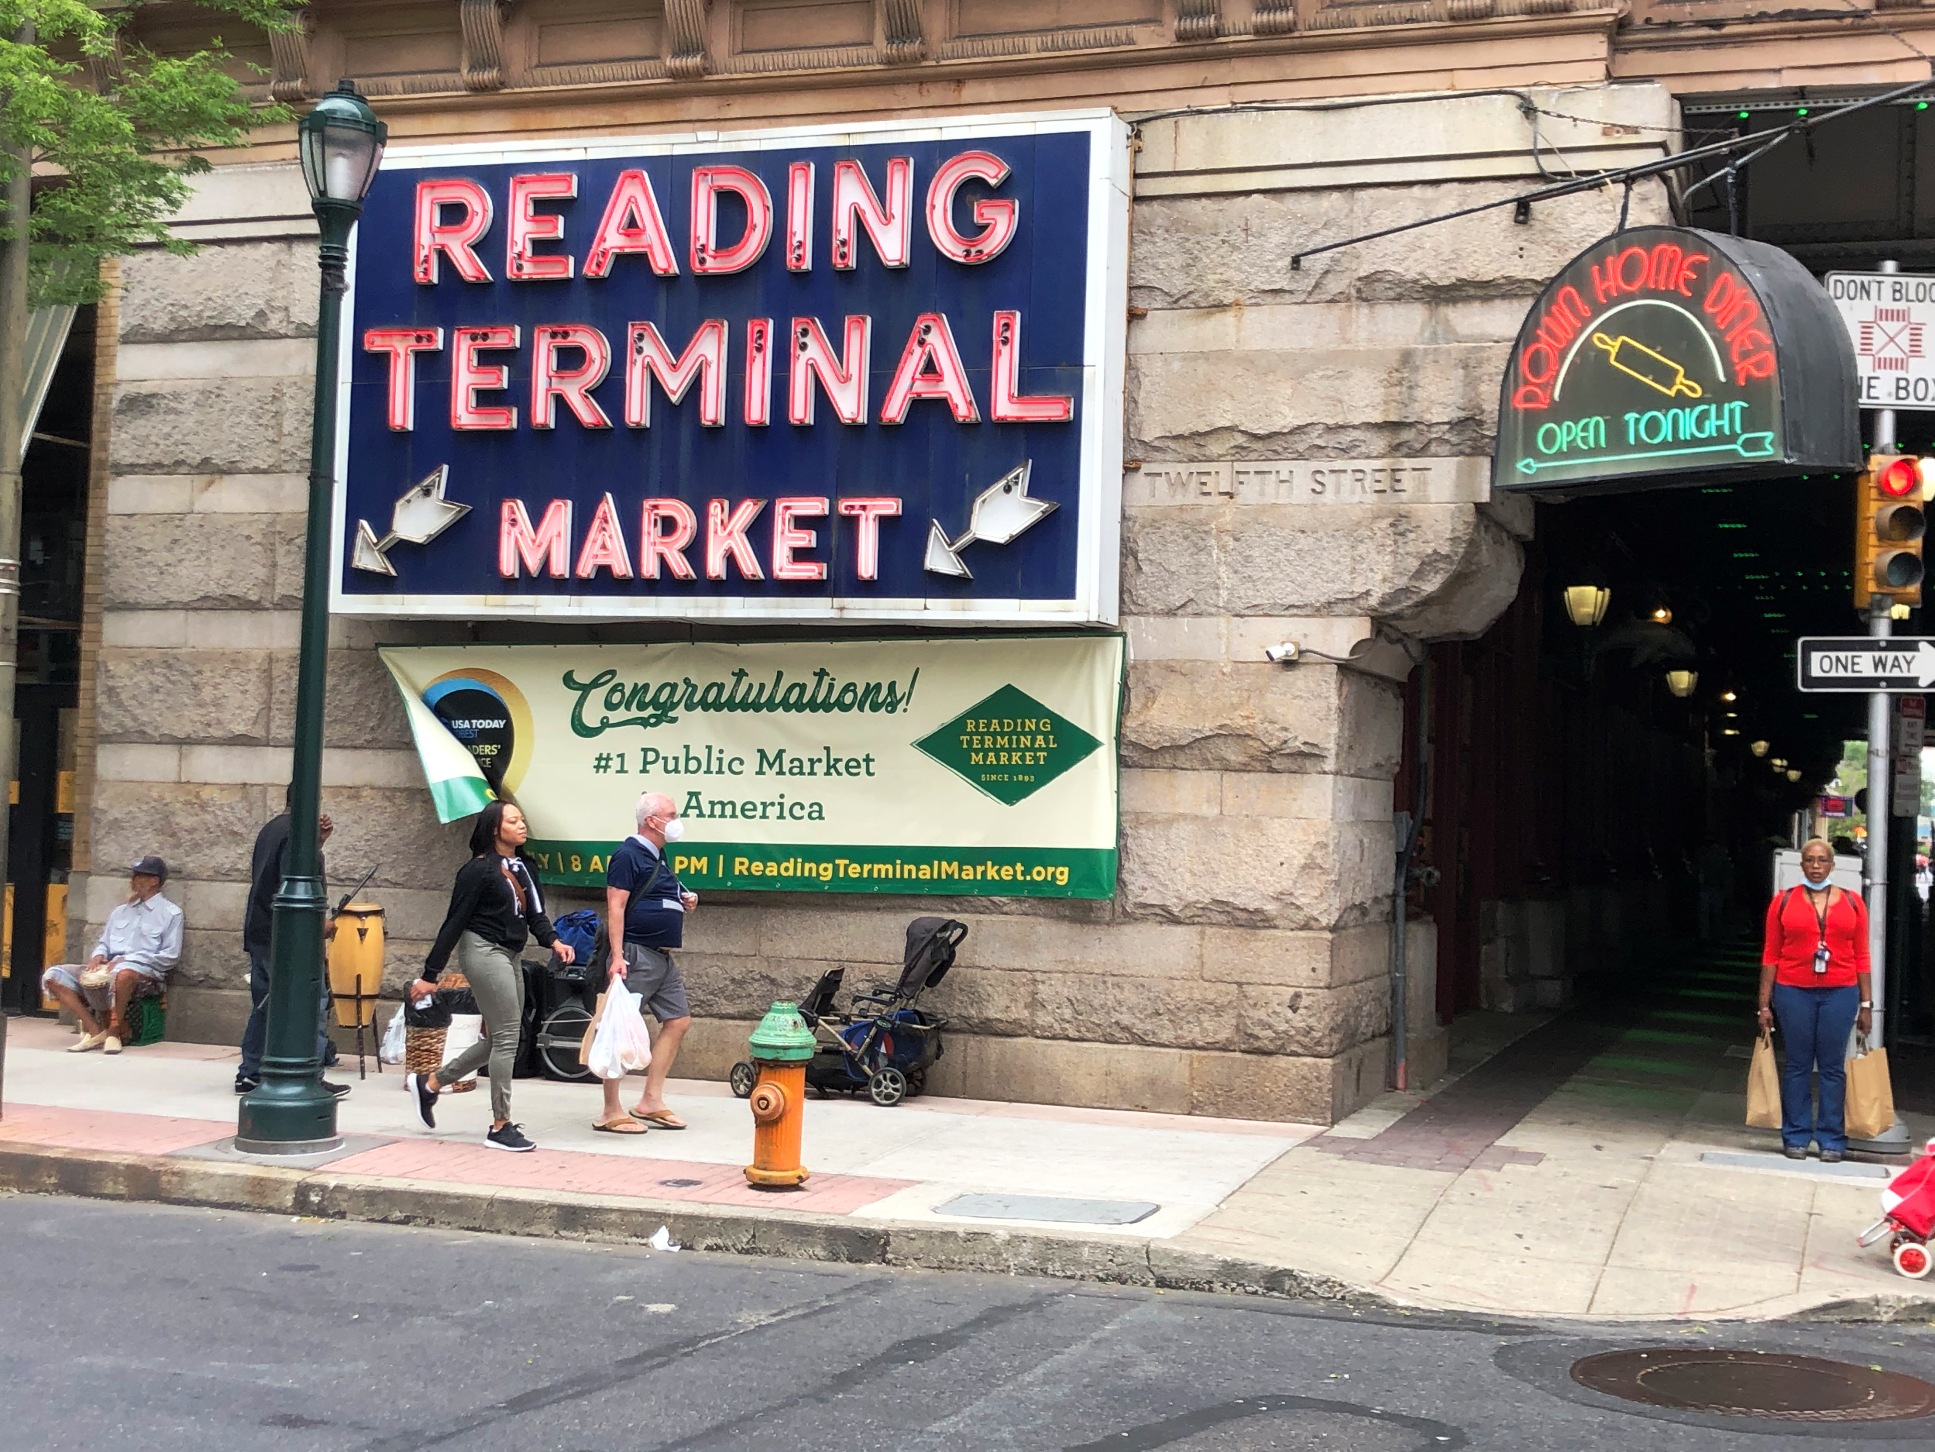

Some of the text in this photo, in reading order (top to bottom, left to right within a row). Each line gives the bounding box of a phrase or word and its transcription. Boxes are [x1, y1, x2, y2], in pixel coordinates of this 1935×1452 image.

[413, 150, 1019, 284] READING
[1512, 243, 1776, 409] DOWN HOME DINER
[364, 310, 1074, 431] TERMINAL
[1537, 401, 1749, 454] OPEN TONIGHT
[1144, 467, 1432, 498] TWELFTH STREET
[500, 492, 902, 580] MARKET
[1819, 655, 1916, 673] ONE WAY
[562, 667, 920, 738] Congratulations!
[451, 719, 507, 729] USA TODAY
[966, 718, 1051, 732] READING
[960, 735, 1057, 748] TERMINAL
[593, 745, 876, 777] #1 Public Market
[970, 752, 1048, 765] MARKET
[680, 791, 826, 820] America
[571, 855, 581, 872] 8
[589, 855, 612, 872] A
[674, 856, 708, 875] PM
[734, 857, 1069, 886] ReadingTerminalMarket.org
